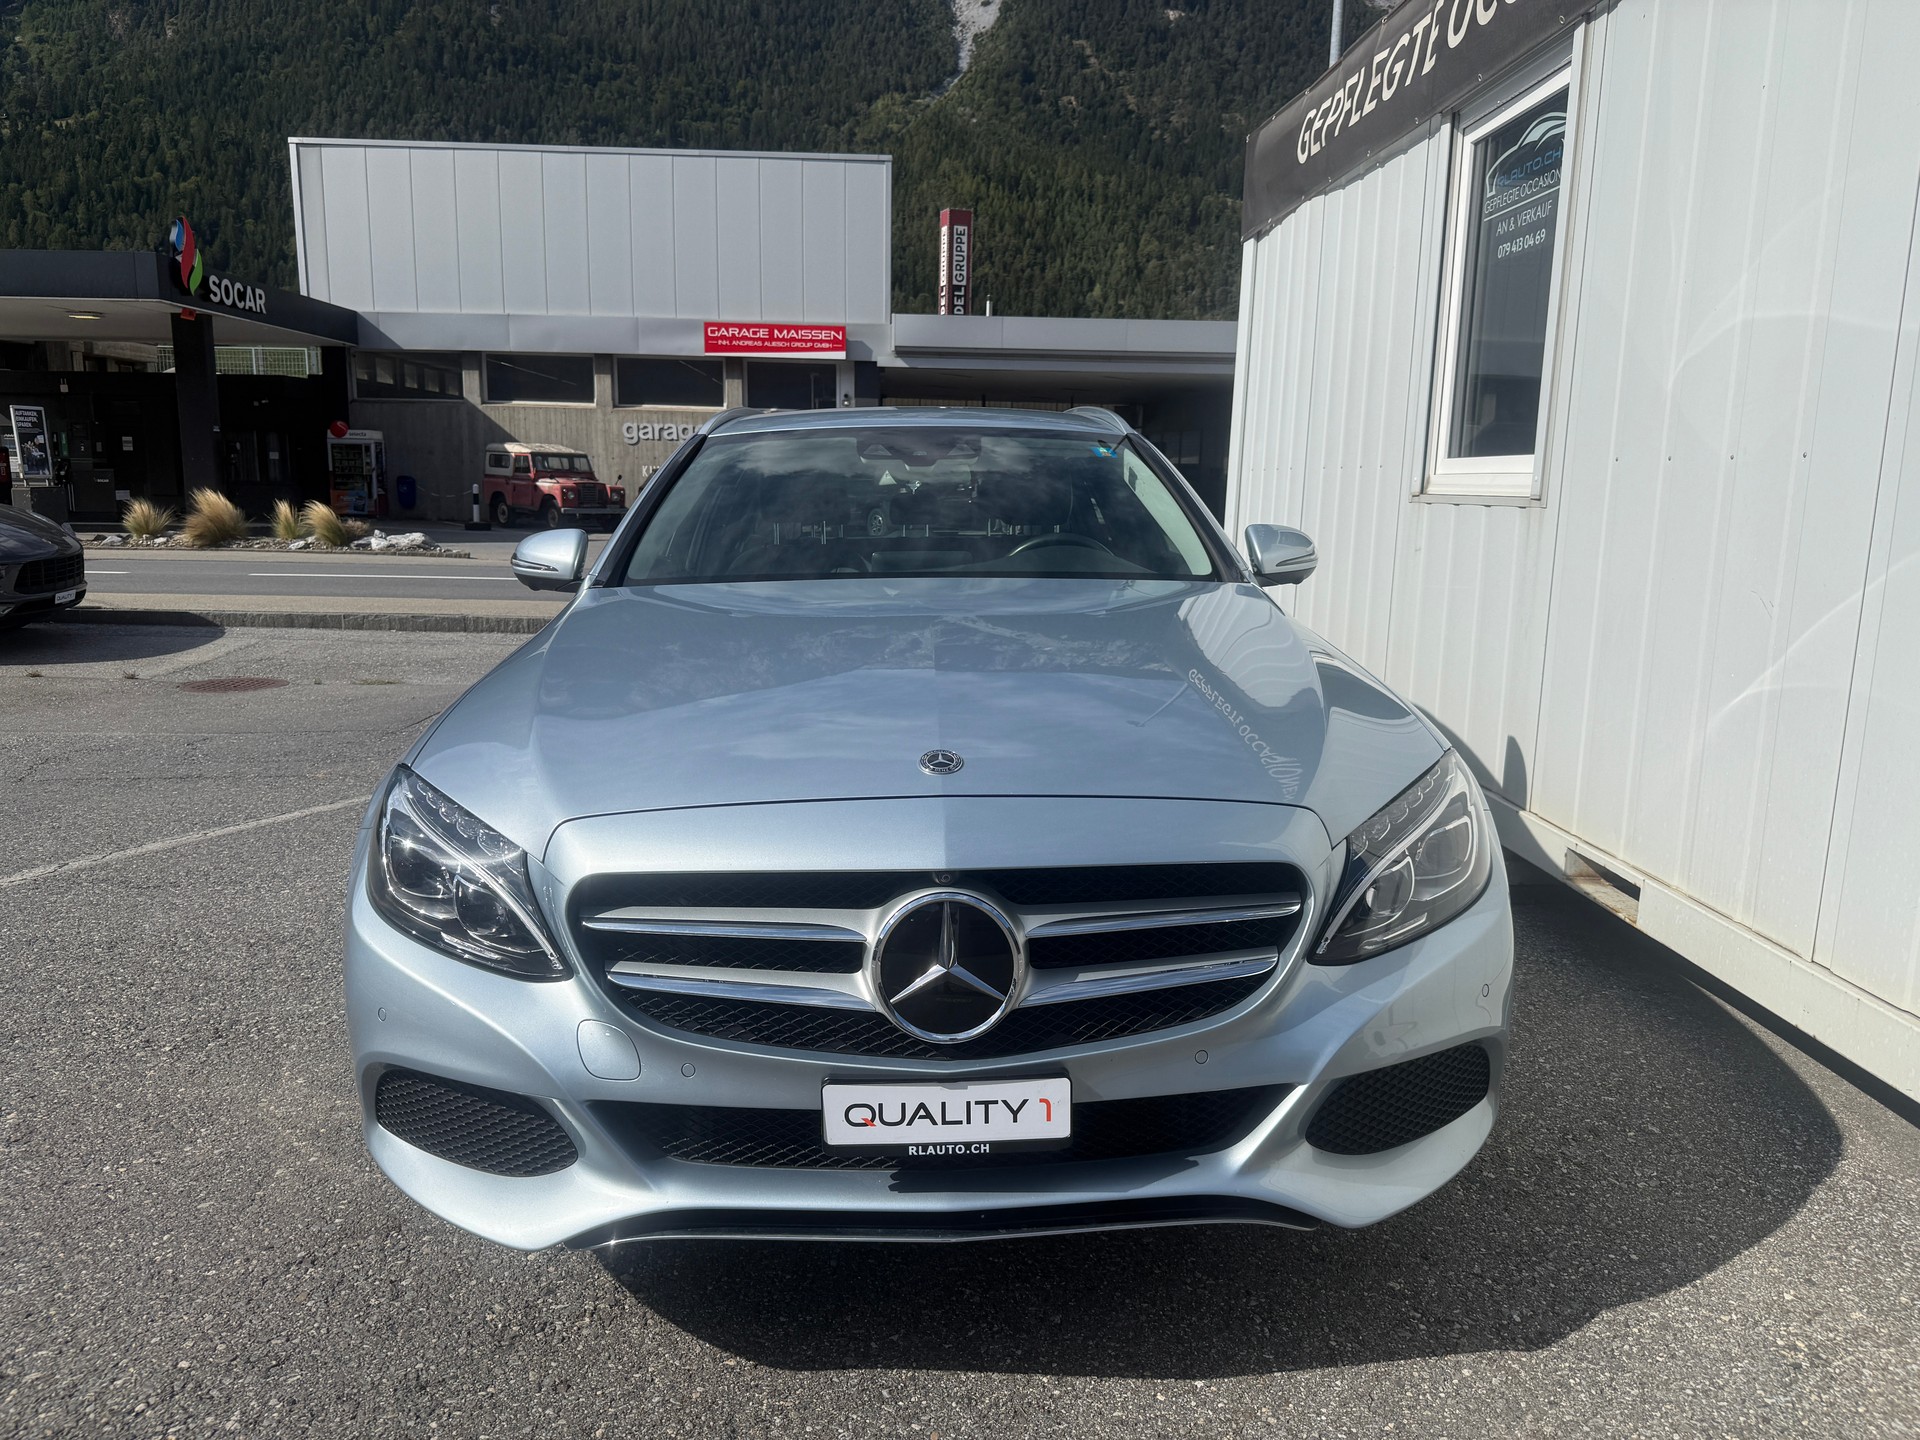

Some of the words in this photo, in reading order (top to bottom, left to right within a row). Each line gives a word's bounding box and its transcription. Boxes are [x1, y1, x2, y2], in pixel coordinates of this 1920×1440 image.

[1297, 0, 1445, 163] GEPFLEGTE
[1484, 187, 1520, 214] GEPFLEGTE
[1496, 221, 1508, 237] AN
[1517, 200, 1553, 228] VERKAUF
[955, 227, 966, 283] GRUPPE
[1497, 242, 1511, 259] 079
[1511, 237, 1523, 253] 413
[1524, 233, 1534, 249] 04
[1535, 228, 1546, 244] 69
[209, 274, 267, 315] SOCAR
[707, 327, 769, 339] GARAGE
[774, 329, 842, 340] MAISSEN
[622, 422, 703, 446] garag
[844, 1098, 1029, 1128] QUALITY
[1039, 1098, 1052, 1122] 1
[908, 1143, 990, 1156] RLAUTO.CH
